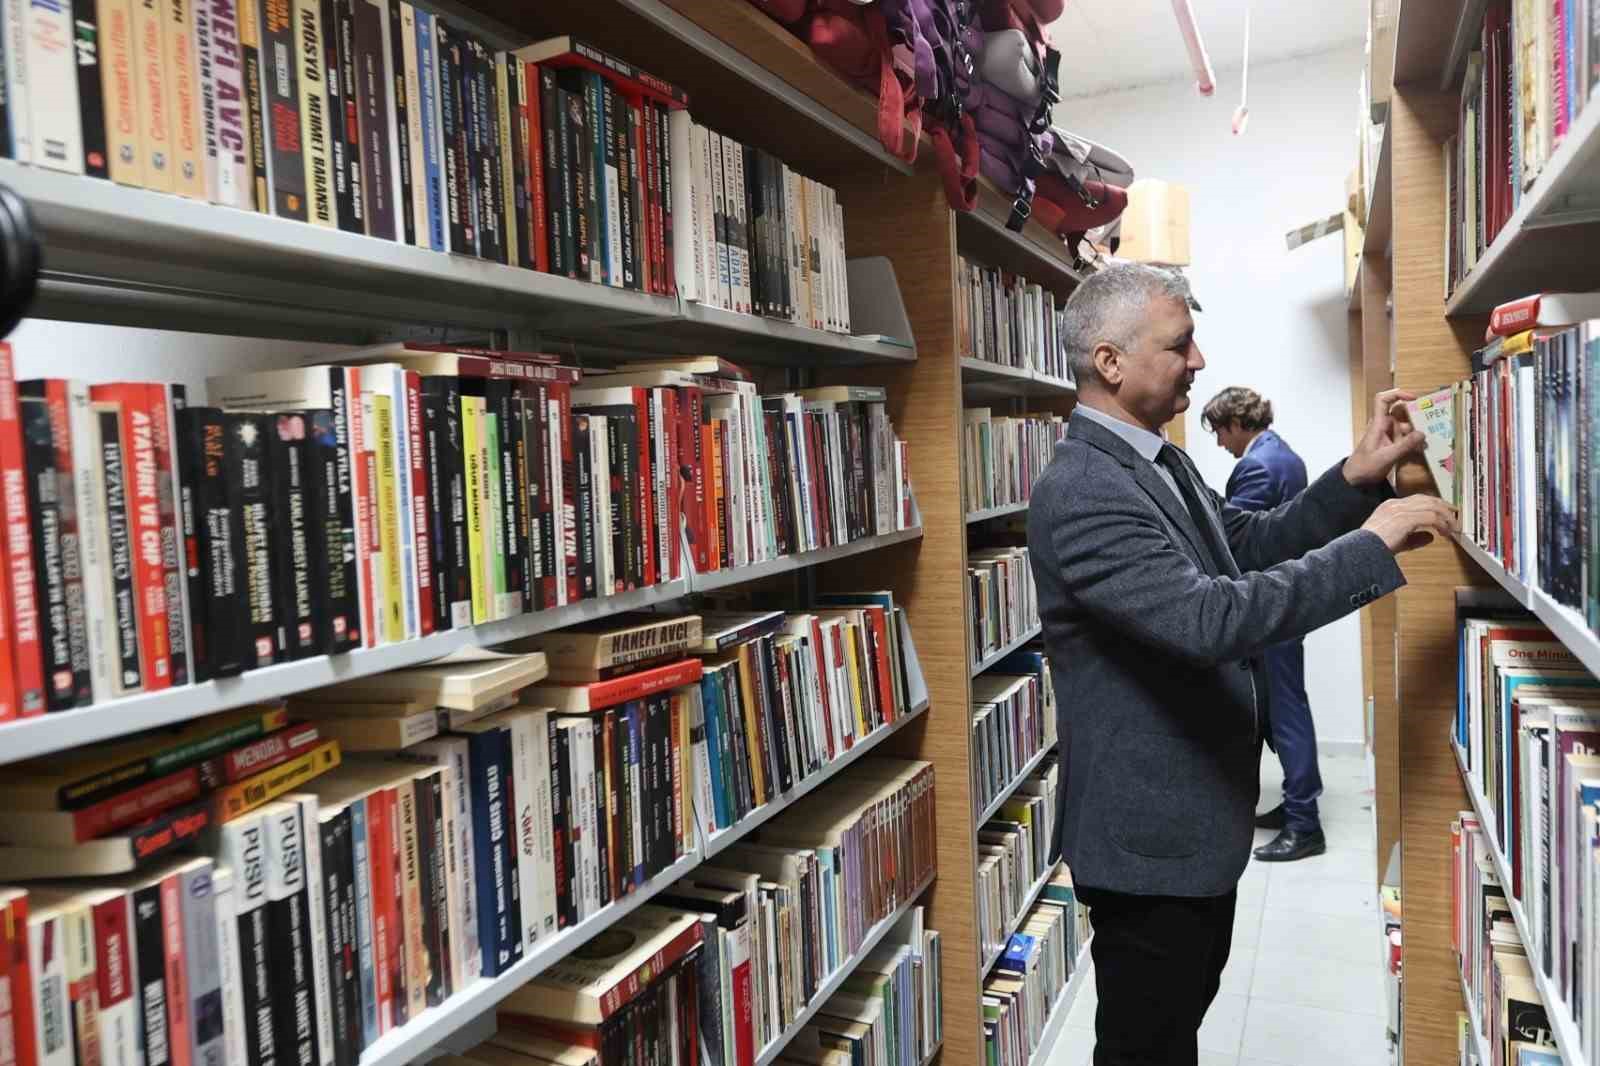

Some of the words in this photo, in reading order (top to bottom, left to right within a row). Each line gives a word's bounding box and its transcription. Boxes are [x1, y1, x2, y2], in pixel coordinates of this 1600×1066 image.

[307, 92, 325, 152] MEHMET
[311, 156, 330, 222] BARANSU
[446, 148, 460, 197] ÇÖLAŞAN
[718, 245, 730, 285] ADAM
[730, 249, 742, 288] ADAM
[332, 388, 347, 444] TOYGUN
[102, 442, 123, 508] PAZARI
[132, 410, 157, 497] ATATÜRK
[336, 447, 350, 494] ATILLA
[139, 504, 158, 530] VE
[289, 493, 304, 528] KANLA
[563, 503, 577, 557] MAYIN
[9, 523, 31, 554] BİR
[107, 511, 129, 581] ÖRGÜT
[141, 530, 162, 566] CHP
[291, 530, 307, 567] ABDEST
[14, 559, 38, 643] TÜRKİYE
[295, 567, 311, 617] ALANLAR
[612, 626, 656, 653] HANEFİ
[659, 621, 688, 643] AVCI
[1509, 648, 1534, 658] One
[486, 764, 501, 801] YOLU
[489, 801, 503, 842] ÇIKIŞ
[242, 827, 264, 901] PUSU
[257, 1006, 273, 1057] AHMET
[279, 815, 302, 887] PUSU
[295, 990, 310, 1040] AHMET
